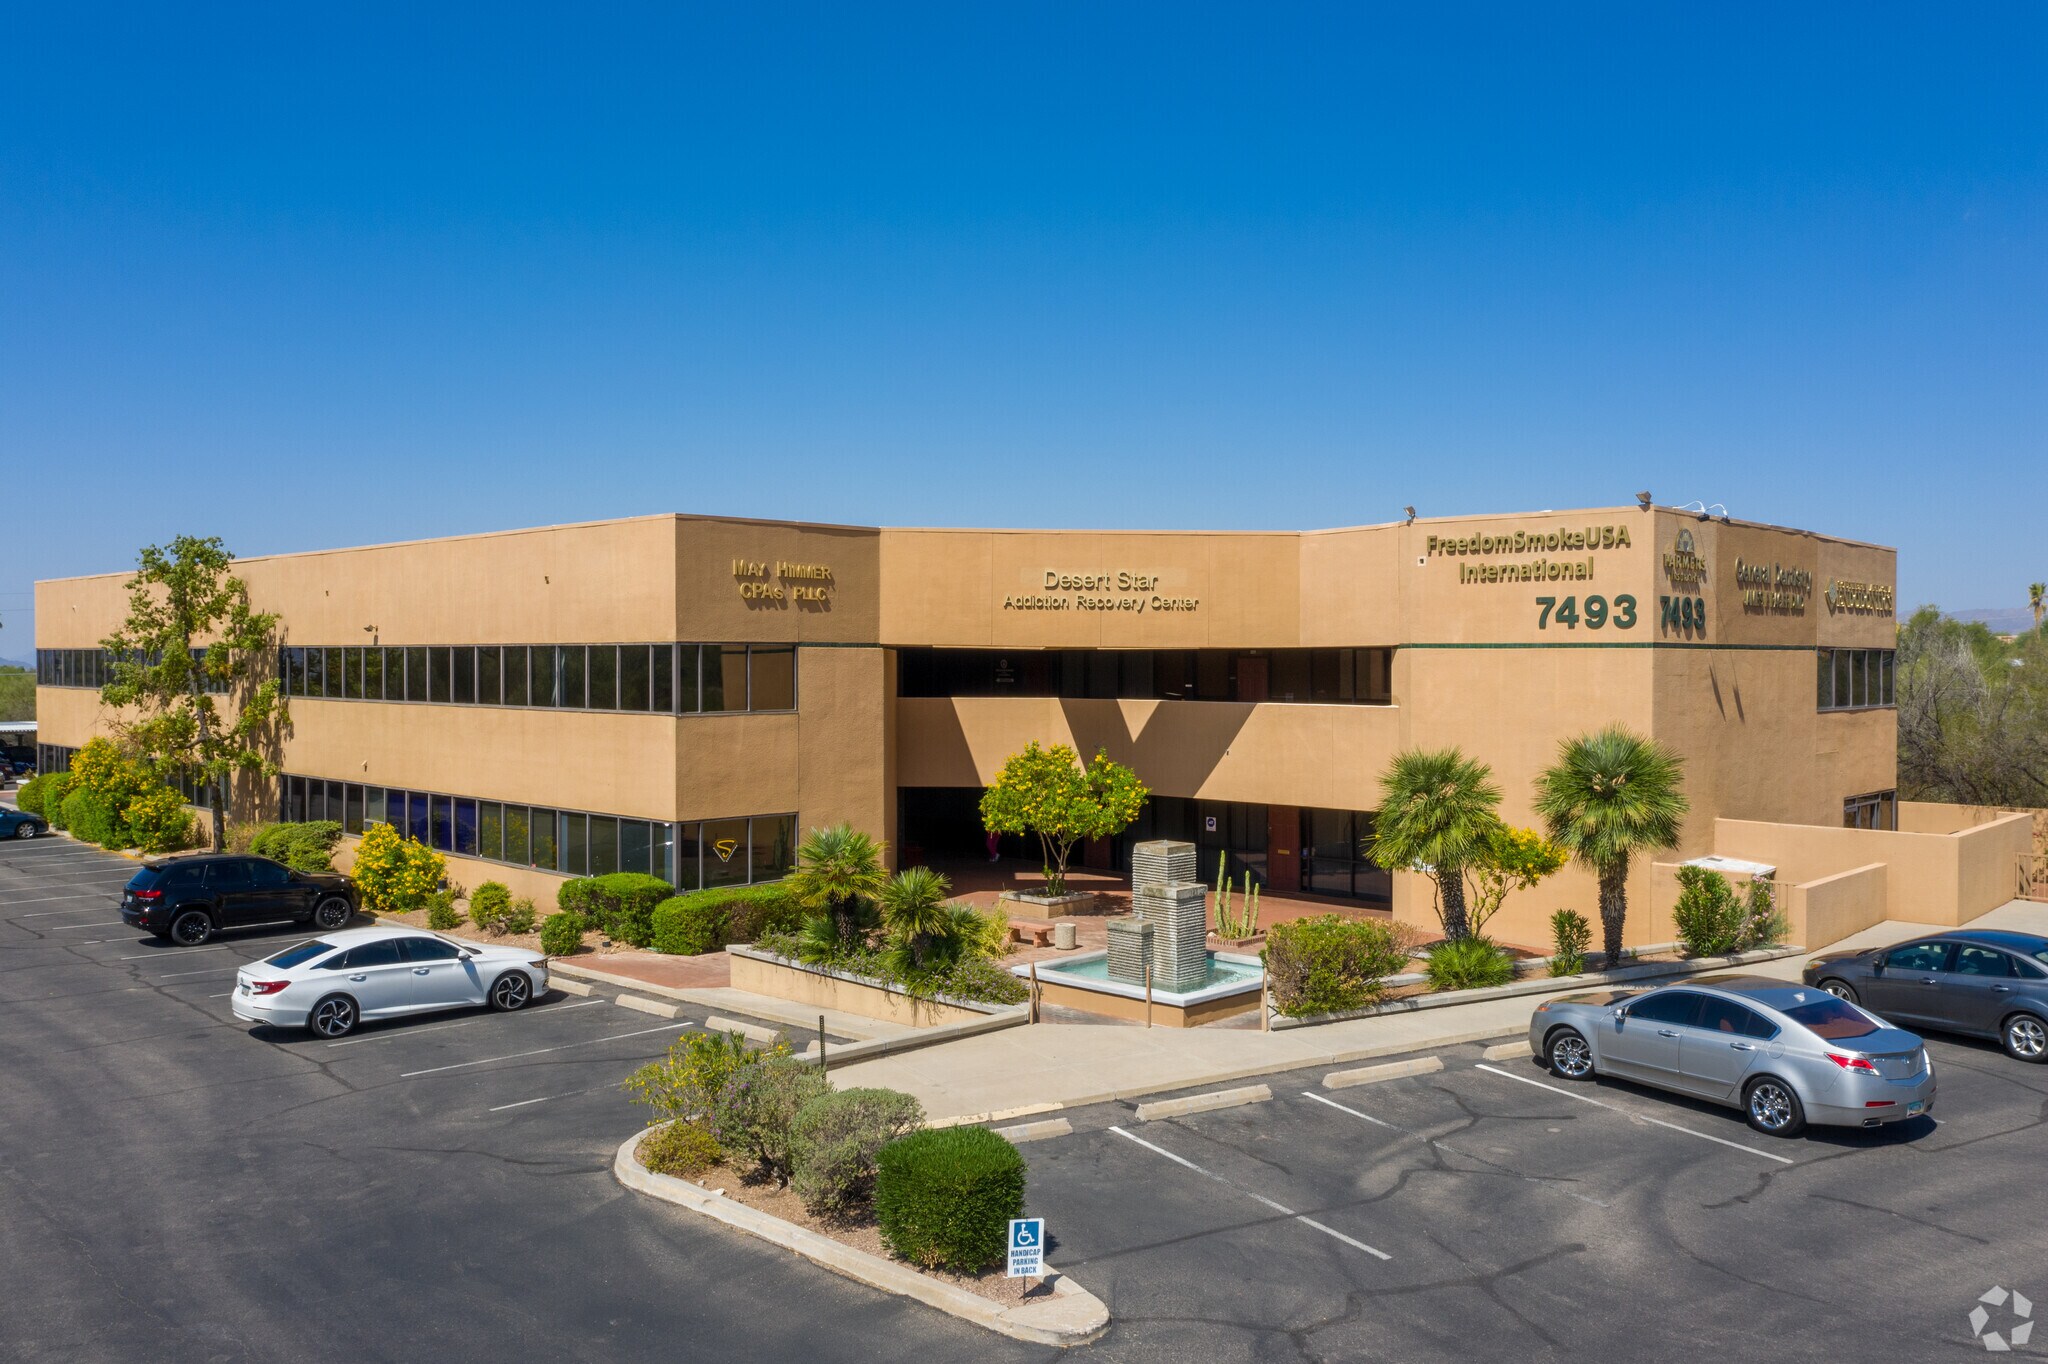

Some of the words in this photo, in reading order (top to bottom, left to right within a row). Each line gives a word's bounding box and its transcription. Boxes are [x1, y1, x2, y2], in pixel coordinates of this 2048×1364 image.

[1426, 525, 1631, 555] FreedomSmokeUSA
[1459, 556, 1594, 583] International
[1044, 570, 1110, 591] Desert
[1117, 570, 1158, 591] Star
[740, 582, 784, 600] CPAs
[793, 586, 826, 601] PLLC
[1003, 595, 1069, 610] Addiction
[1076, 595, 1145, 614] Recovery
[1151, 595, 1200, 611] Center
[1535, 594, 1638, 629] 7493
[1660, 595, 1706, 630] 7493
[1011, 1249, 1041, 1257] HANDICAP
[1013, 1258, 1038, 1266] PARKING
